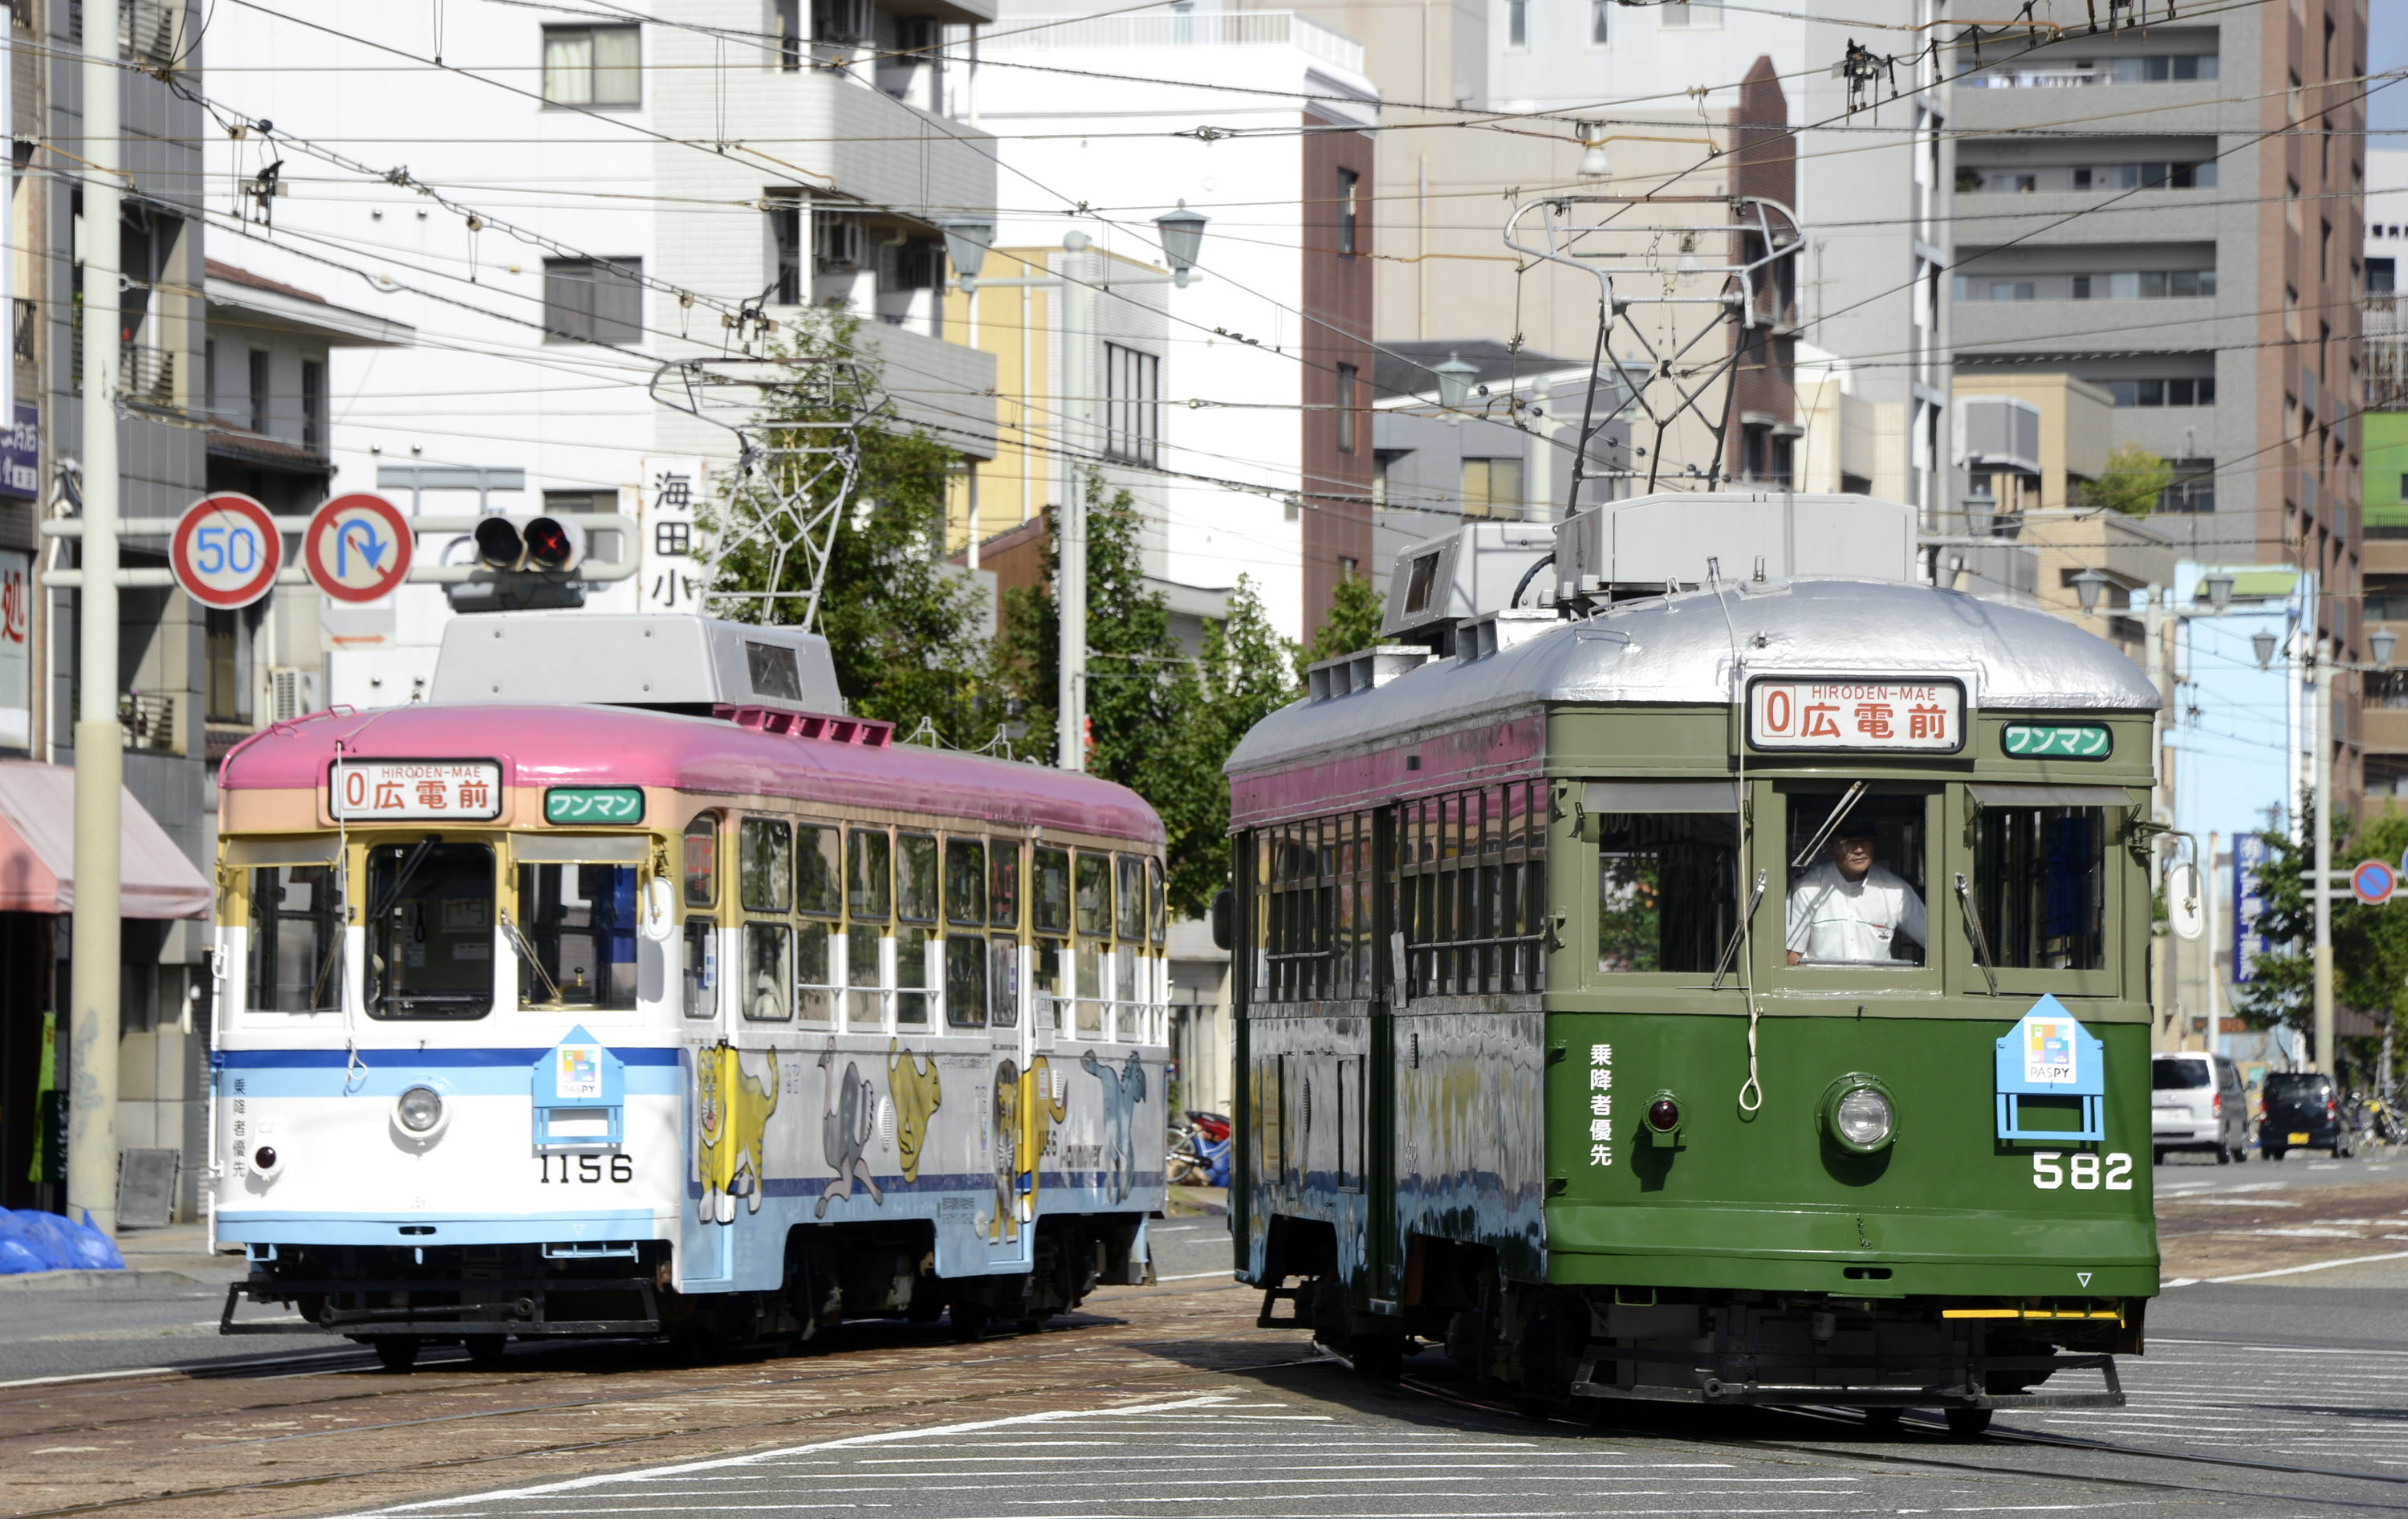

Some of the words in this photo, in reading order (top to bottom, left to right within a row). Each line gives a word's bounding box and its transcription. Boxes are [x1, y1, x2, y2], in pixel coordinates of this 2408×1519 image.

[197, 527, 254, 573] 50
[652, 470, 694, 606] 海田小
[1812, 685, 1936, 701] HIRODEN-MAE
[1767, 690, 1790, 732] 0
[1800, 702, 1947, 739] 広電前
[2007, 727, 2107, 754] ワンマン
[382, 767, 482, 778] HIRODEN-MAE
[346, 772, 364, 806] 0
[373, 780, 490, 810] 広電前
[550, 795, 637, 817] ワンマン
[2030, 1066, 2070, 1078] PASPY
[1589, 1044, 1613, 1167] 乗降者優先
[540, 1154, 633, 1184] 1156
[2032, 1151, 2133, 1190] 582
